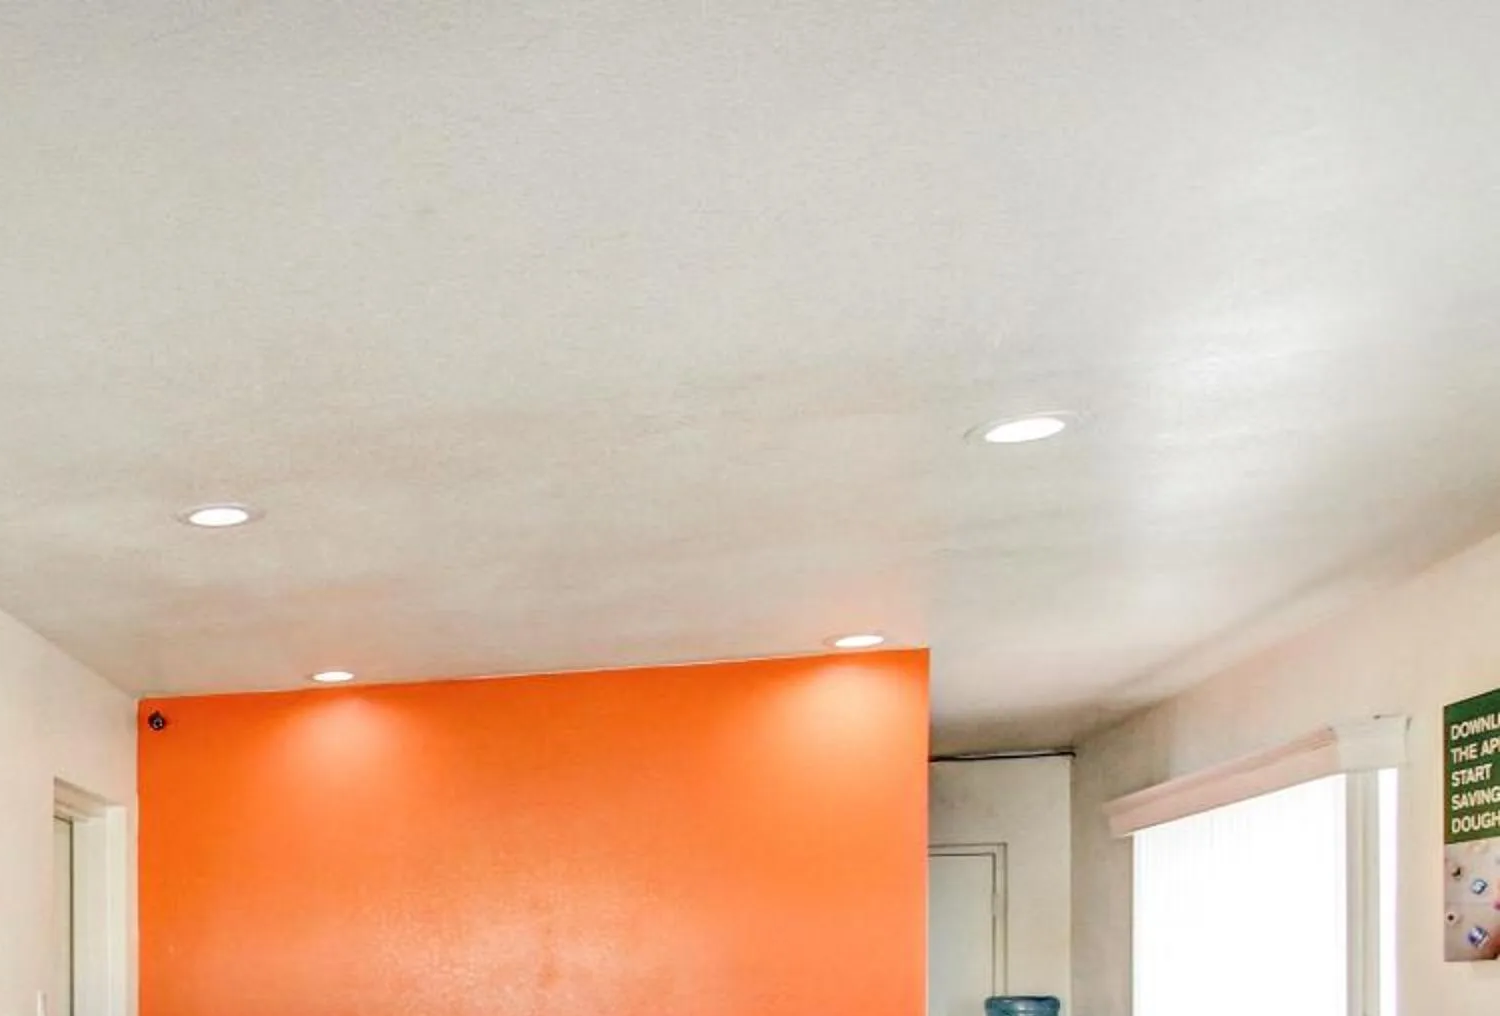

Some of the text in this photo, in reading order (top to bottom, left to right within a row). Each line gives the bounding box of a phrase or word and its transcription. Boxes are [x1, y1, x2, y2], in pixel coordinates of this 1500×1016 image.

[1451, 712, 1500, 740] DOWNL
[1450, 737, 1500, 764] THE AP
[1451, 763, 1492, 787] START
[1451, 810, 1500, 834] DOUGH
